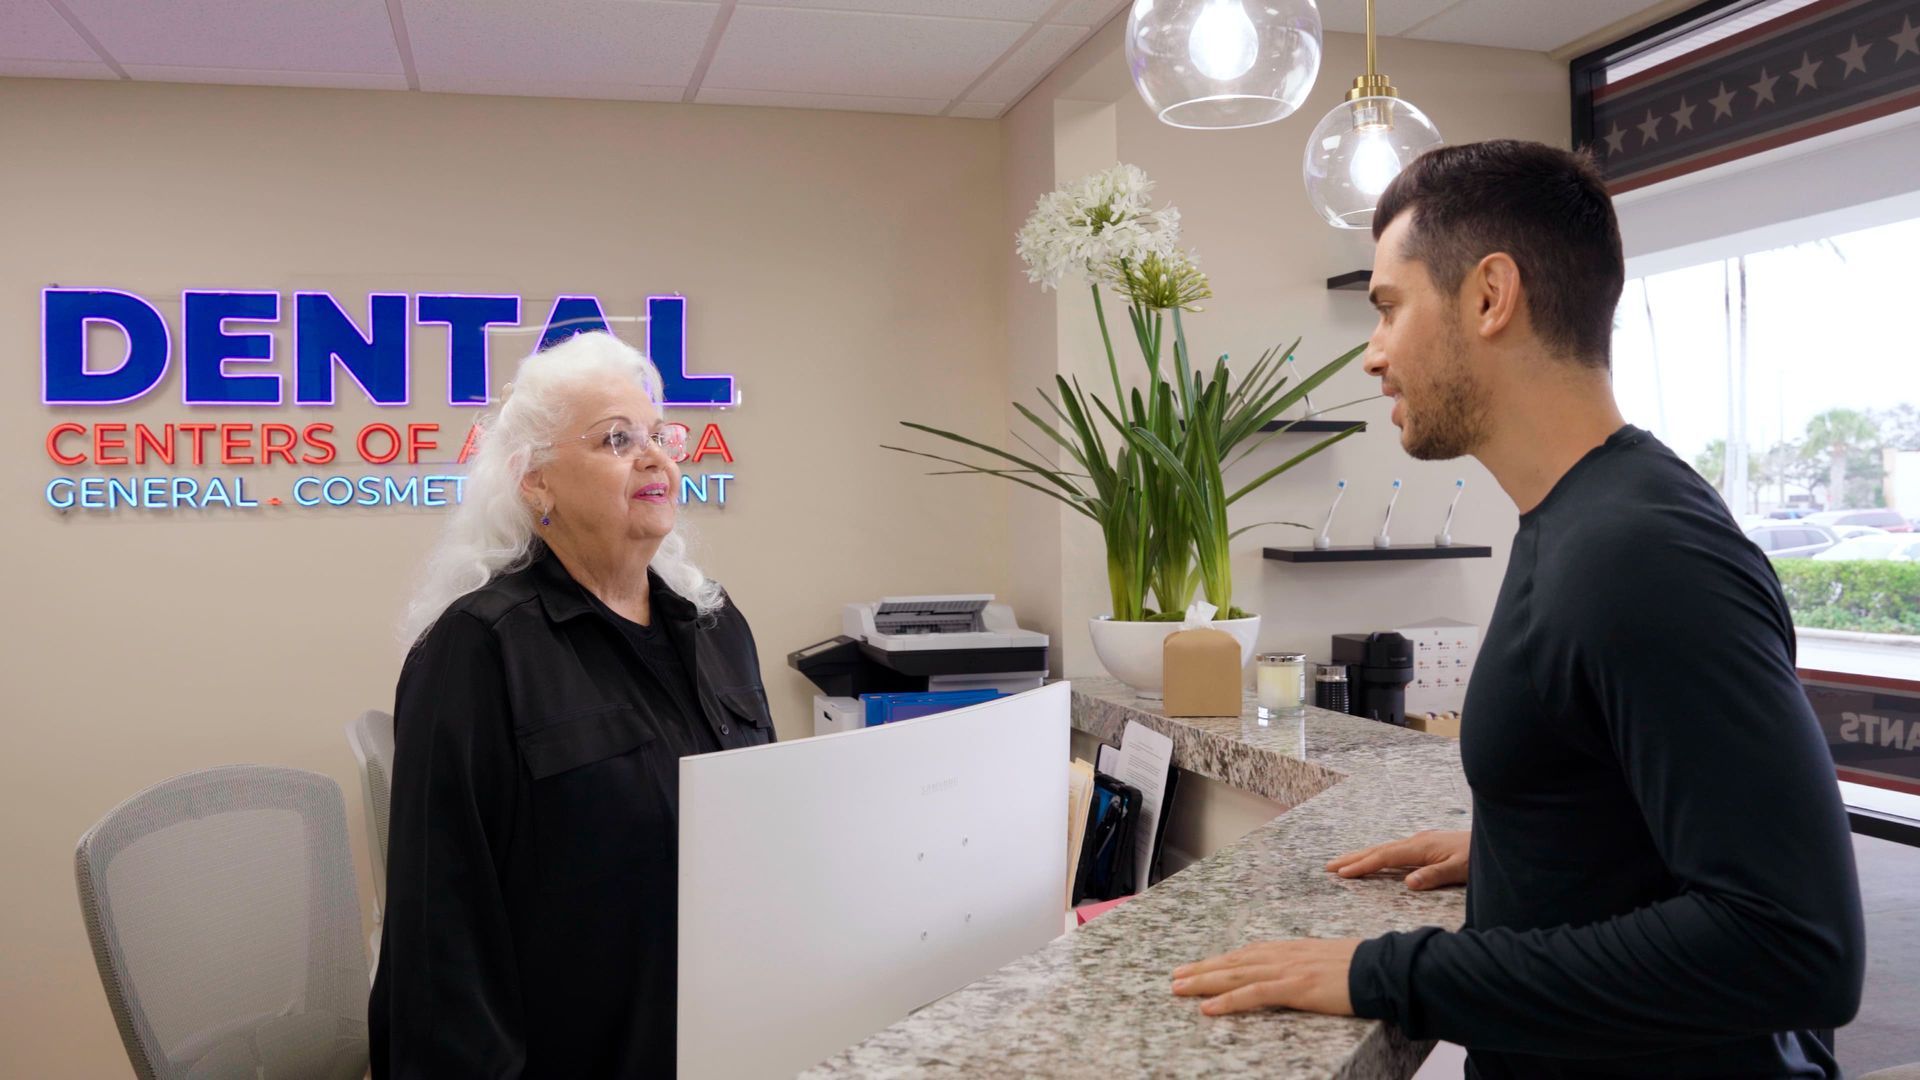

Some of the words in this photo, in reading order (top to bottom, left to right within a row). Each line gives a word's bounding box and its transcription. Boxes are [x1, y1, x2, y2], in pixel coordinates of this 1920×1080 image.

[46, 422, 337, 465] CENTERS
[356, 422, 439, 465] OF
[46, 476, 259, 509] GENERAL
[292, 474, 470, 507] COSMET
